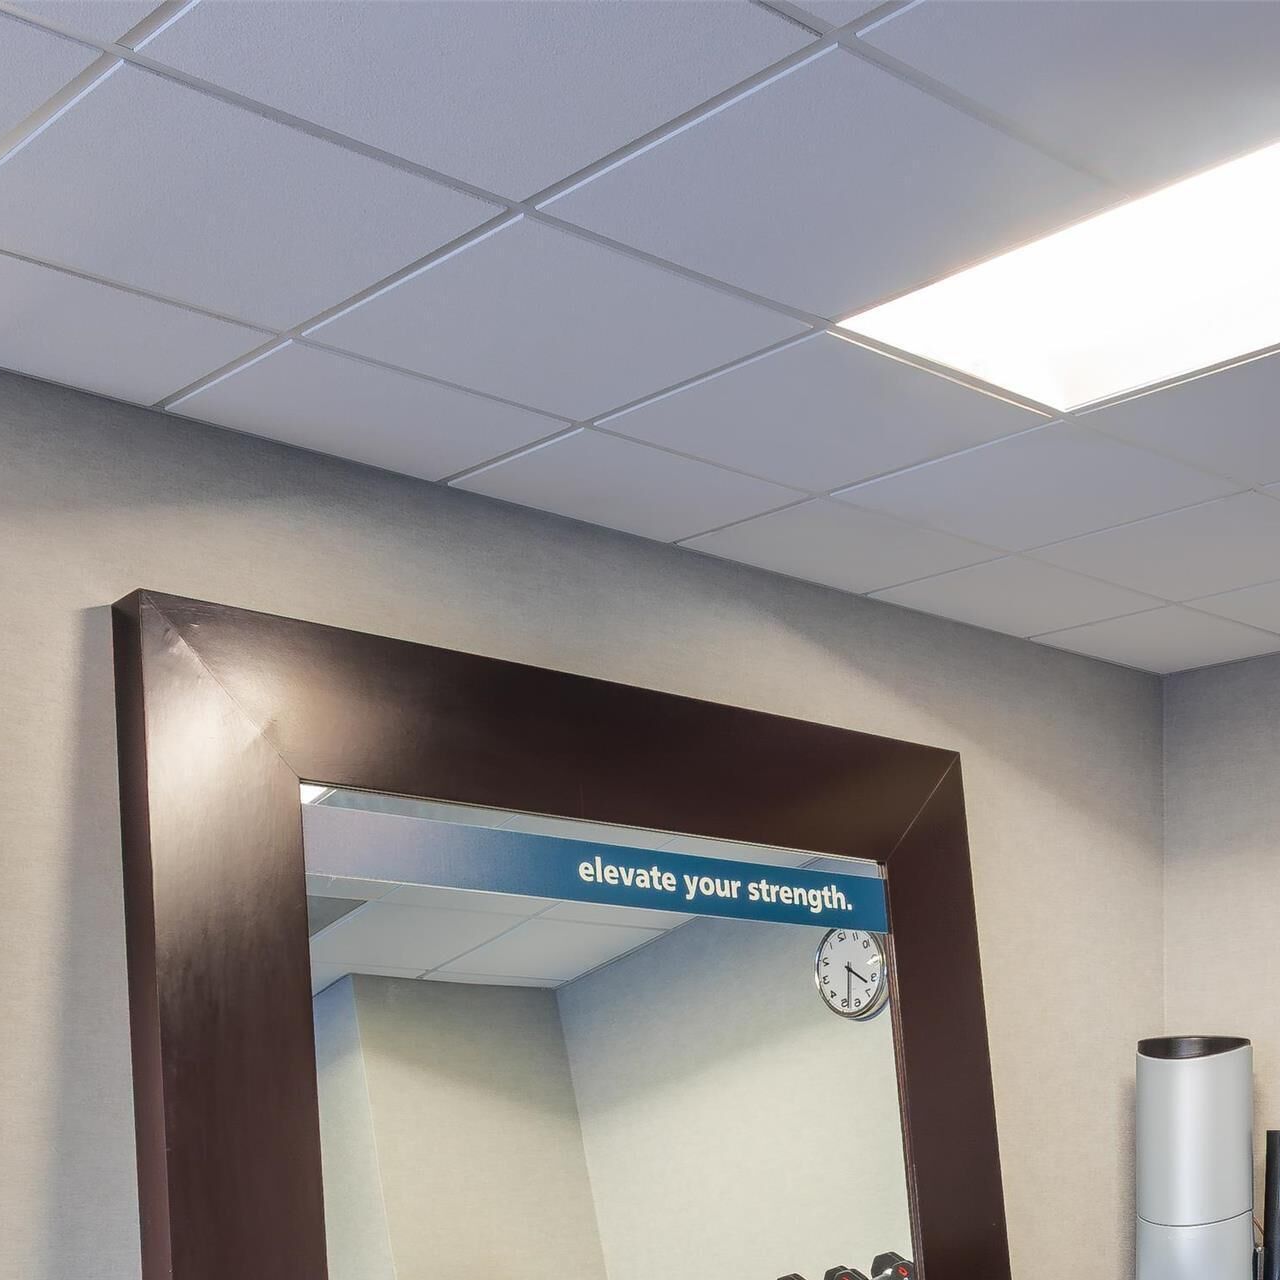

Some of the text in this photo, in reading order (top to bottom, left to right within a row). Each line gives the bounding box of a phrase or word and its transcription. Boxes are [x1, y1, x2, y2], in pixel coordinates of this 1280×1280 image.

[579, 856, 852, 913] elevate your strength.
